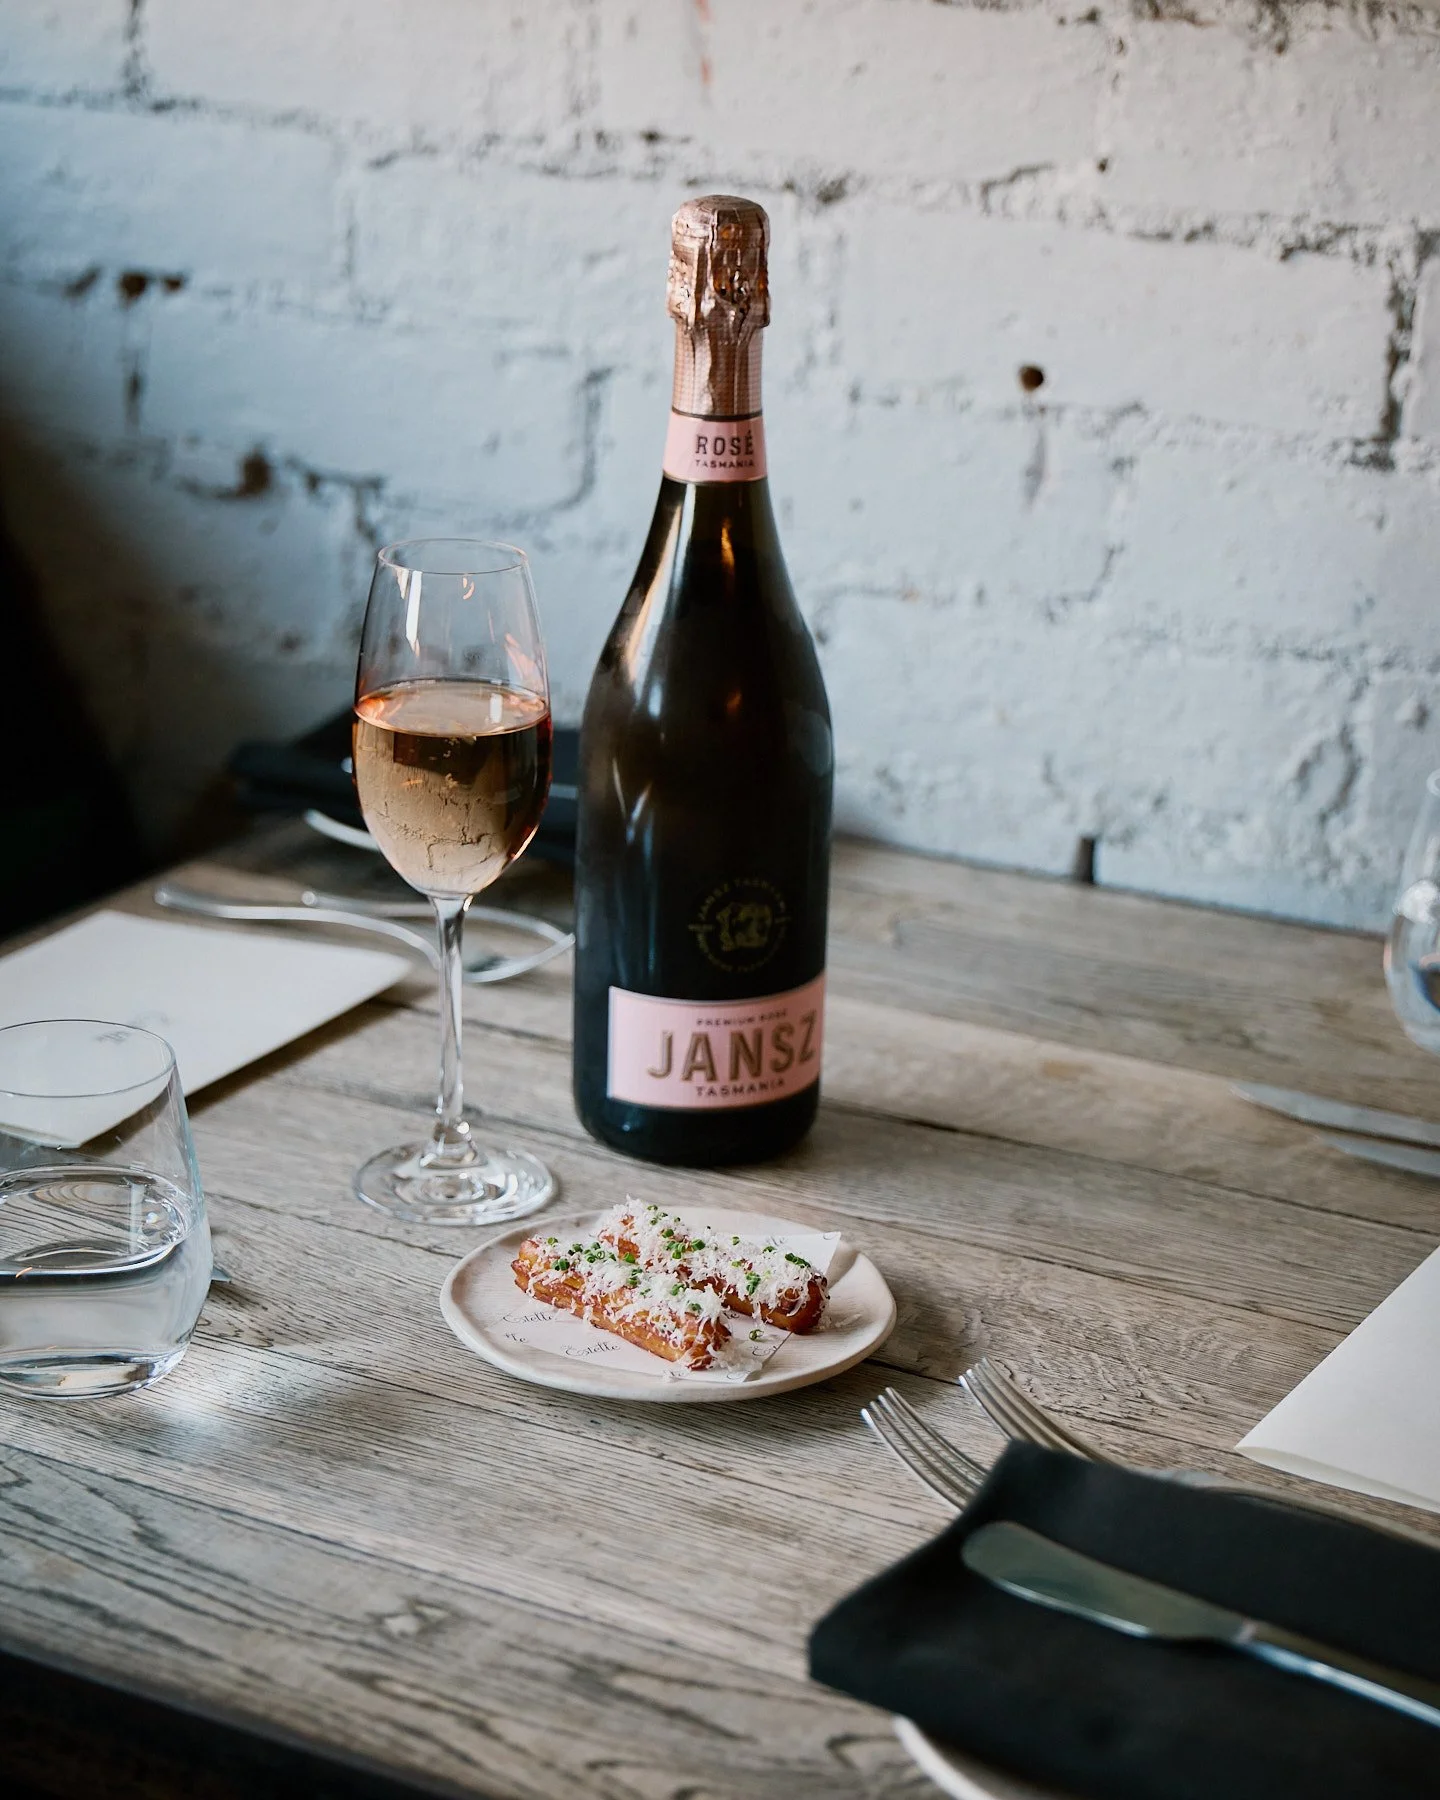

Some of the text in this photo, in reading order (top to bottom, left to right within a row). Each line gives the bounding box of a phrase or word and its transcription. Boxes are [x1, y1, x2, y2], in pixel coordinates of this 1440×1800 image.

[695, 430, 754, 456] ROSÉ
[695, 459, 754, 468] TASMANIA
[647, 1009, 817, 1082] JANSZ
[696, 1078, 785, 1096] TASMANIA
